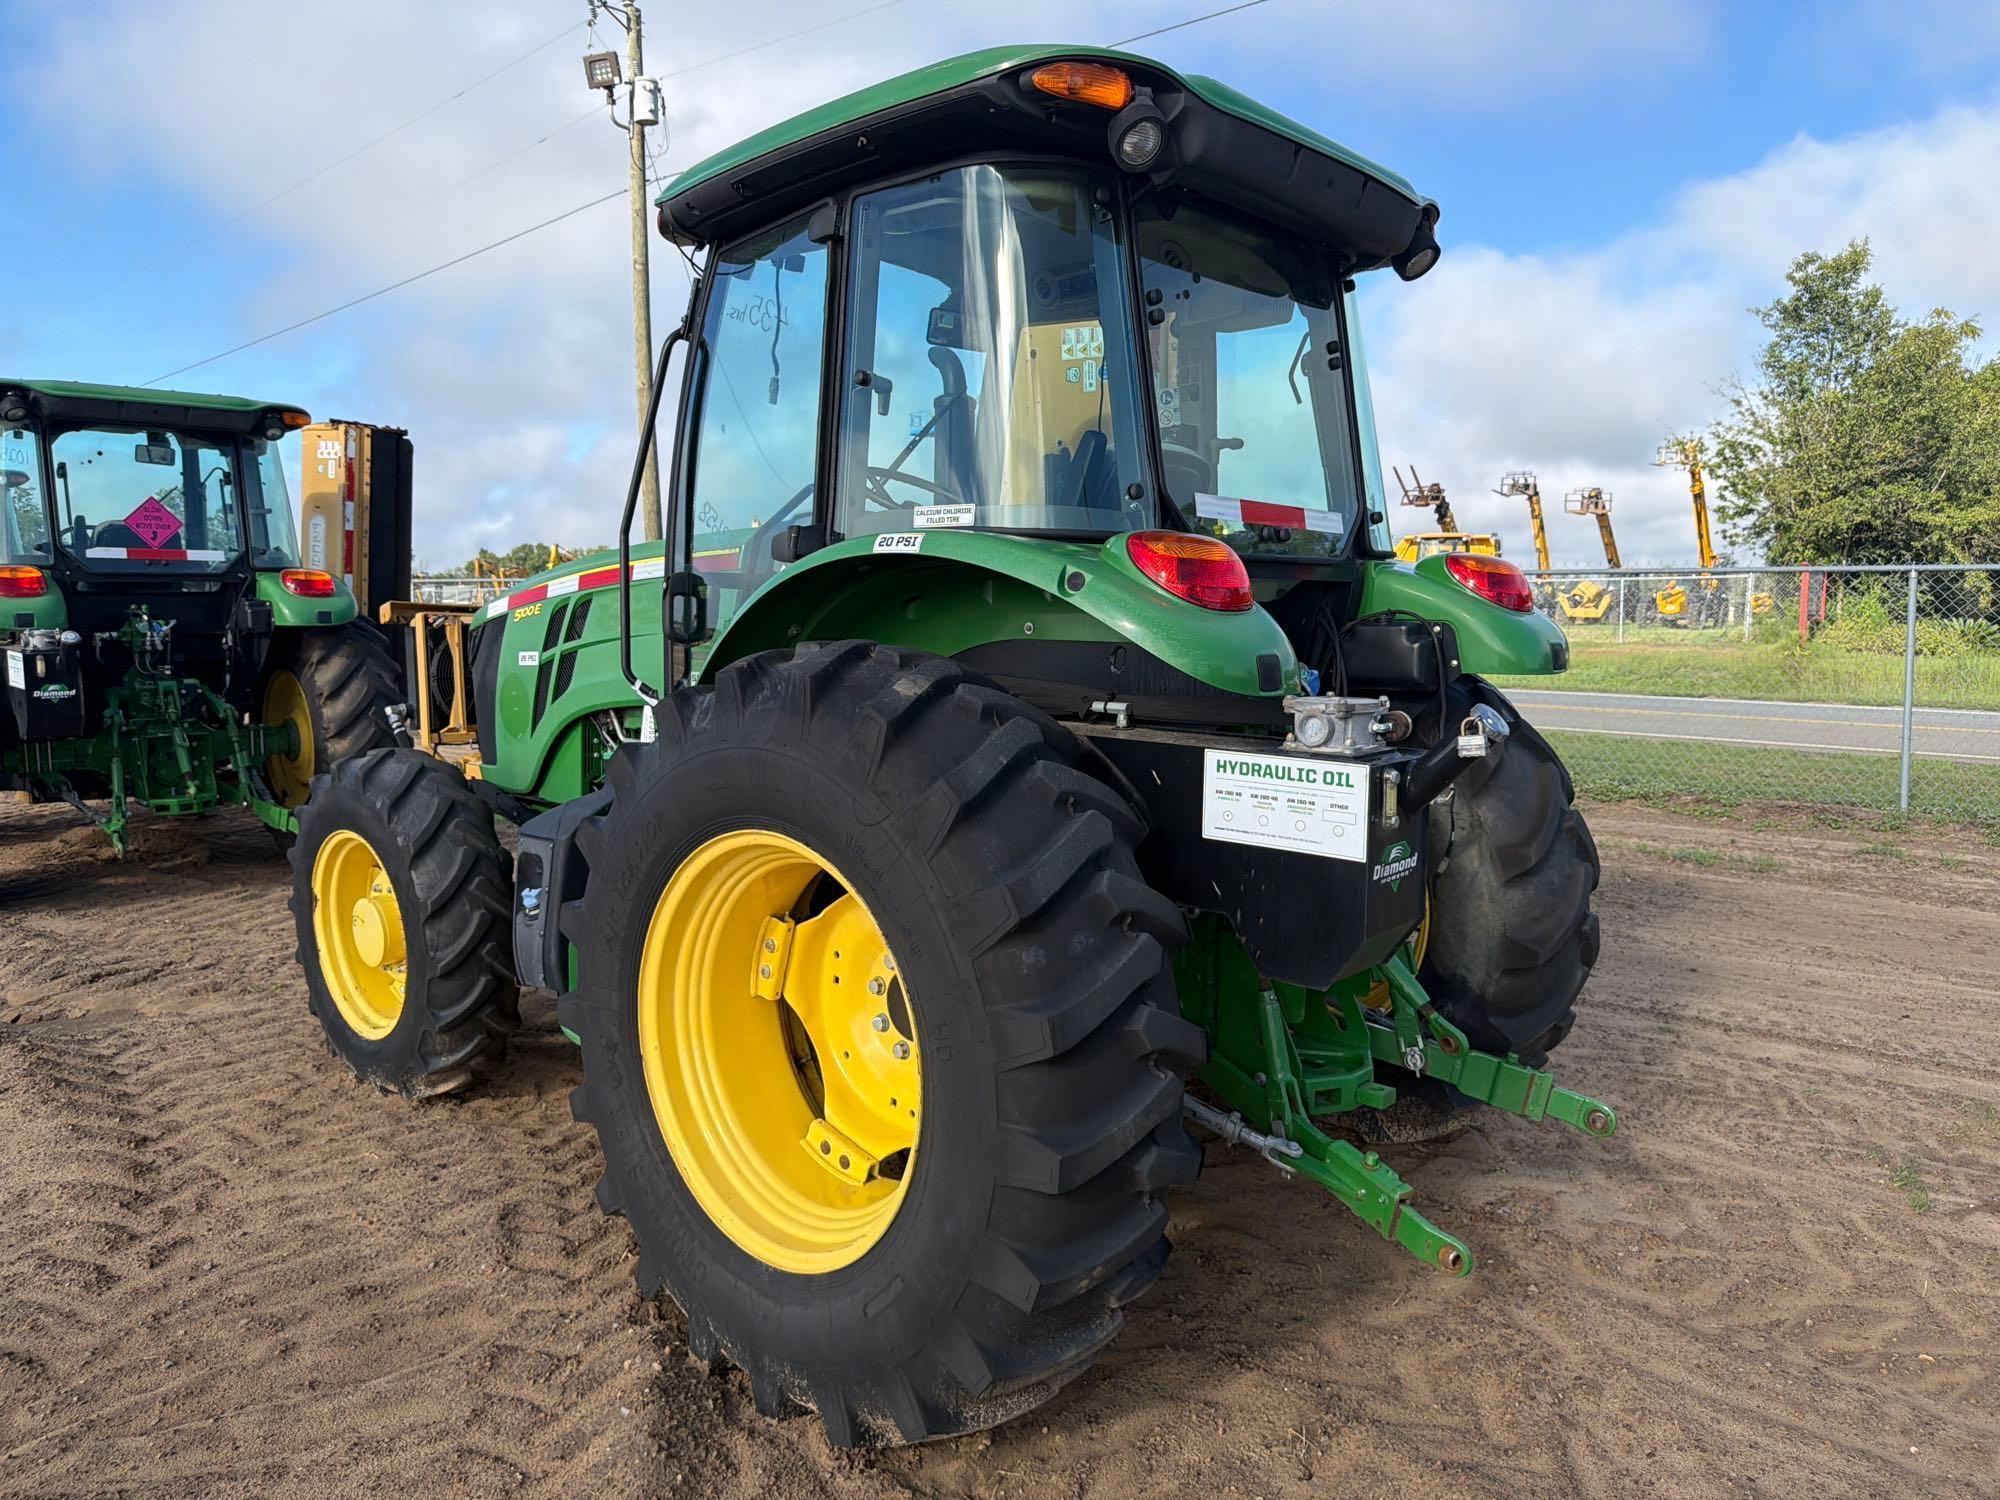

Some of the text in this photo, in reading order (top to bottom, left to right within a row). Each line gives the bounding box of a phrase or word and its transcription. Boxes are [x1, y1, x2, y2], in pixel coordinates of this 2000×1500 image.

[916, 507, 973, 517] CALCIUM CHLORIDE
[878, 536, 919, 547] 20 PSI
[33, 689, 77, 698] Diamond
[1216, 759, 1355, 788] HYDRAULIC OIL
[1373, 852, 1418, 880] Diamond
[1381, 870, 1409, 884] MOWERS
